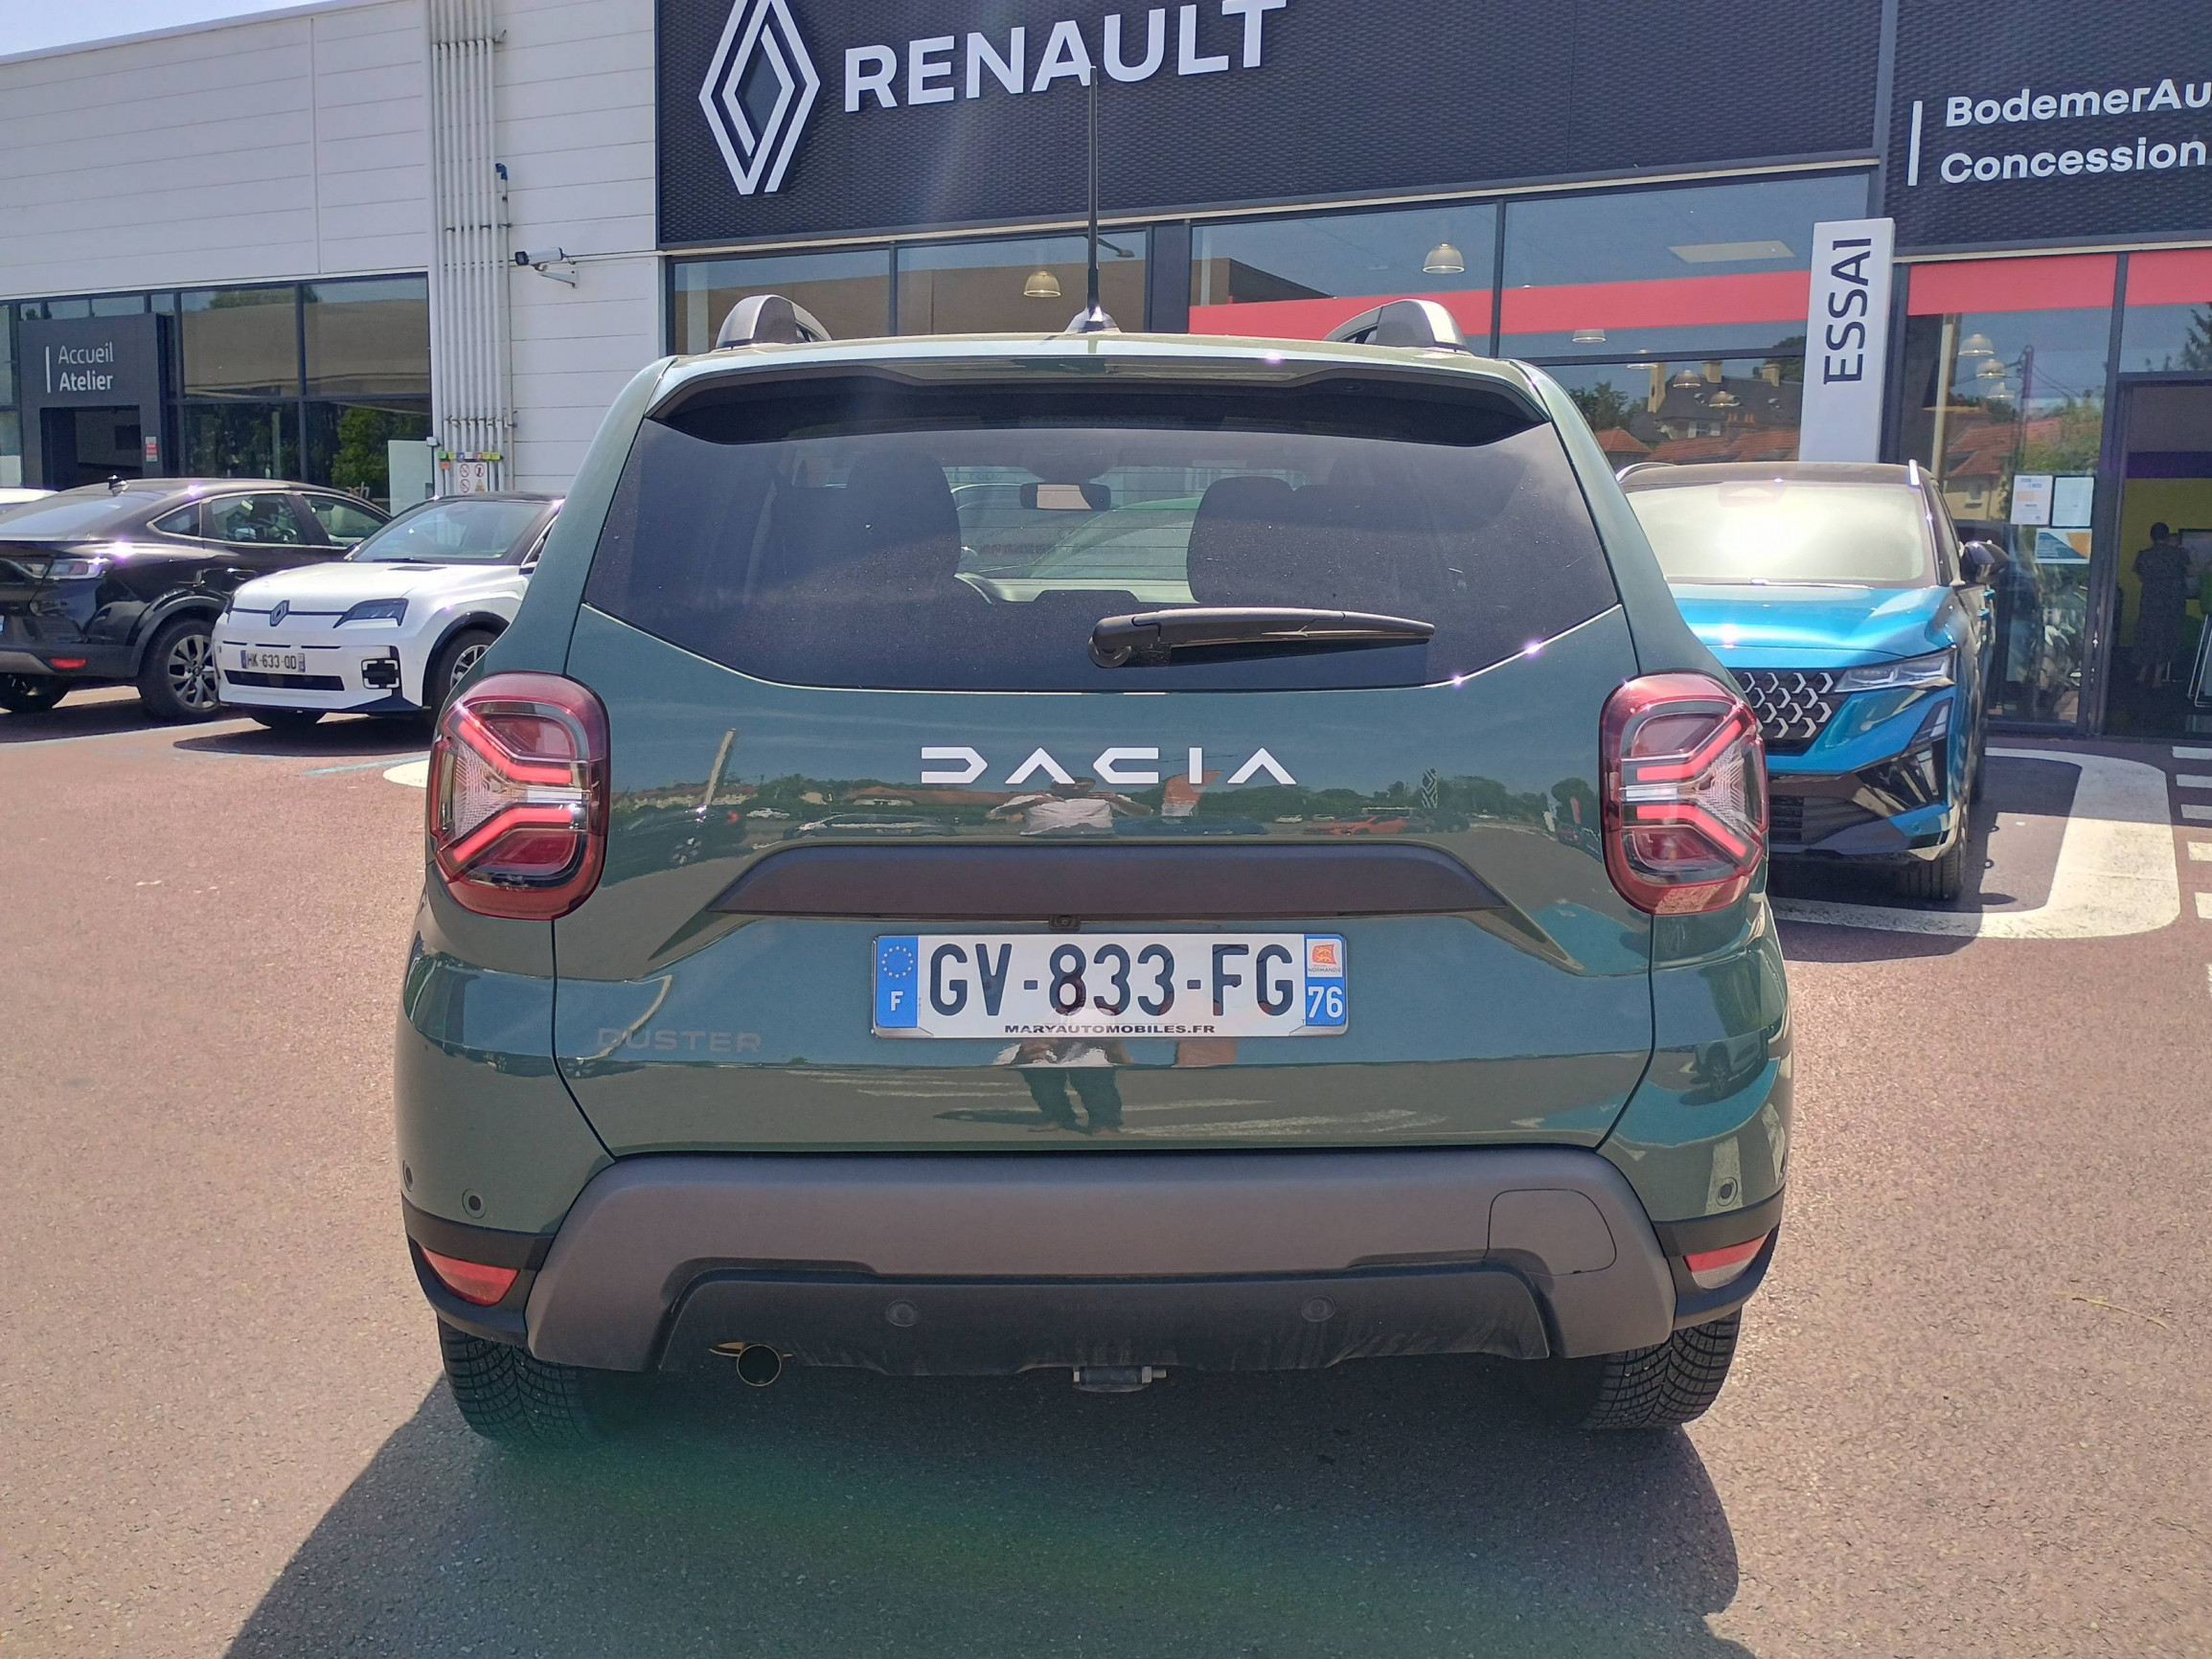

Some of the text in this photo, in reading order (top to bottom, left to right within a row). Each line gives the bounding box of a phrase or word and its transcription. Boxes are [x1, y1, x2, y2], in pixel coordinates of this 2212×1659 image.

[844, 0, 1288, 112] RENAULT
[1945, 79, 2212, 127] BodemerAu
[1940, 136, 2207, 185] Concession
[1823, 238, 1872, 385] ESSAI
[57, 341, 114, 365] Accueil
[58, 370, 114, 393] Atelier
[921, 746, 1297, 784] DACIA
[929, 943, 1294, 1017] GV-833-FG
[890, 990, 904, 1011] F
[1308, 986, 1343, 1018] 76
[597, 1028, 763, 1053] DUSTER
[1004, 1025, 1216, 1034] MARYAUTOMOBILES.FR
